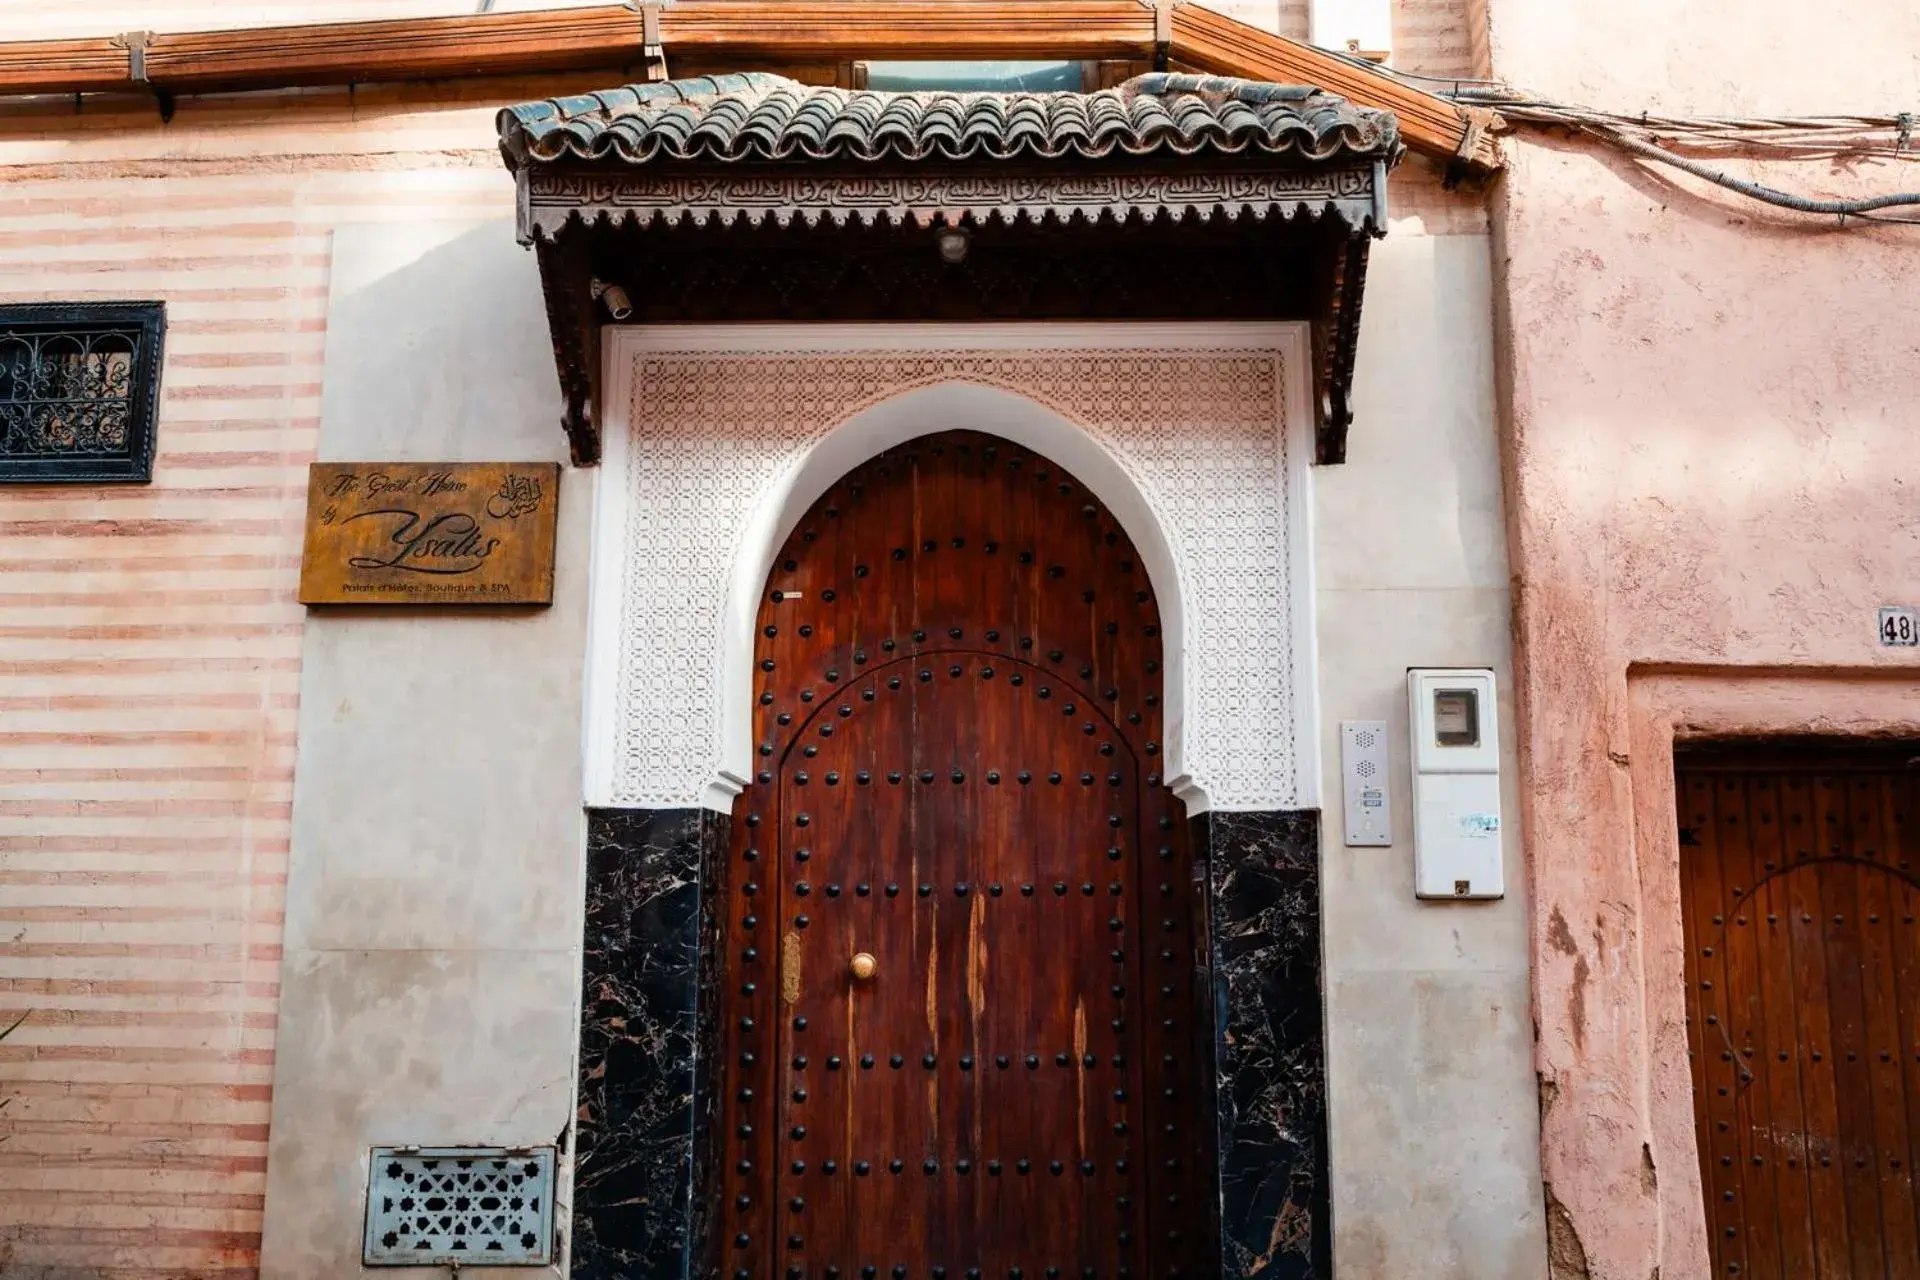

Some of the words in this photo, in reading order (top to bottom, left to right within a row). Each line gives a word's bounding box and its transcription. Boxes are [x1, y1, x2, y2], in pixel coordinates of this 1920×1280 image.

[324, 473, 359, 497] The
[361, 472, 411, 500] Guest
[415, 472, 468, 497] House
[321, 504, 337, 526] by
[342, 583, 375, 593] Palais
[427, 583, 476, 593] Boutique
[480, 583, 487, 593] &
[491, 583, 510, 593] SPA
[1884, 616, 1910, 641] 48
